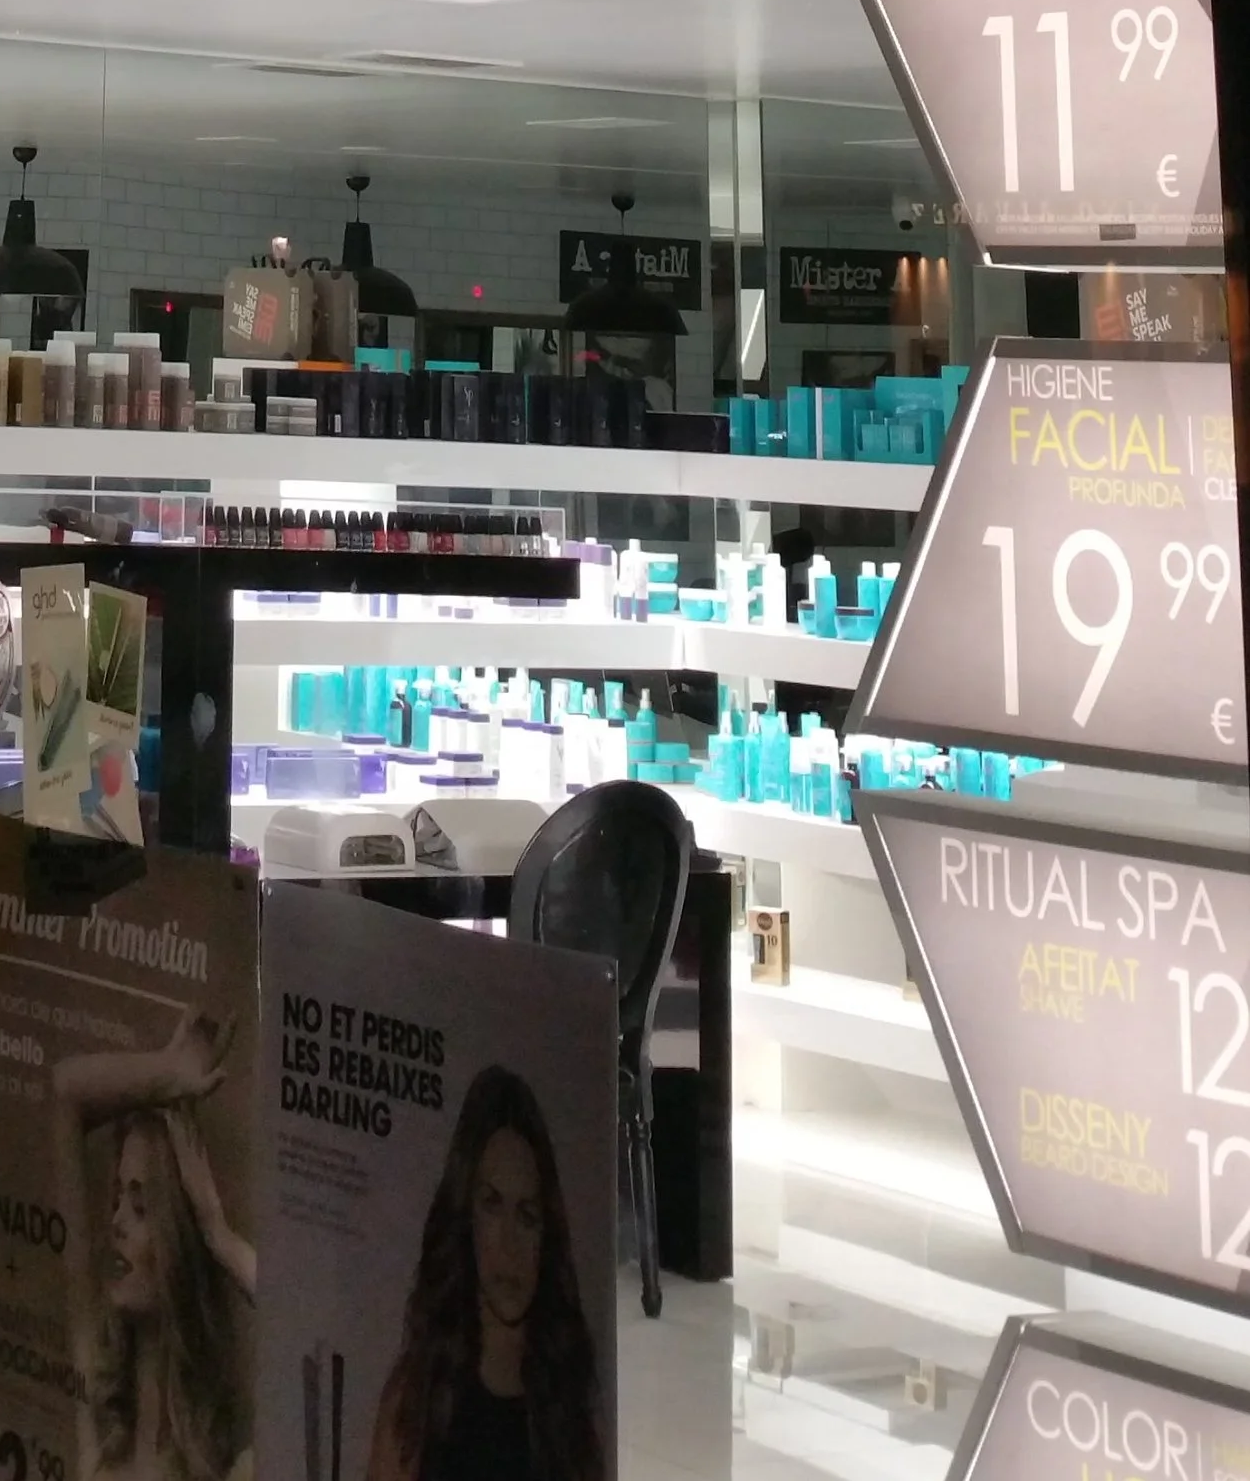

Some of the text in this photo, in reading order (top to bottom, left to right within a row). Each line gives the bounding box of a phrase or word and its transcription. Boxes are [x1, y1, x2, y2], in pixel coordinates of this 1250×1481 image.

[982, 5, 1180, 198] 11 99 €
[789, 255, 883, 291] Mister
[1125, 288, 1147, 311] SAY
[1129, 306, 1149, 327] ME
[1133, 314, 1172, 341] SPEAK
[1007, 364, 1113, 401] HIGIENE
[1010, 407, 1181, 475] FACIAL
[1069, 476, 1186, 509] PROFUNDA
[32, 584, 57, 619] ghd
[982, 525, 1235, 744] 19 99 €
[941, 837, 1227, 954] RITUAL SPA
[78, 903, 209, 984] Promotion
[1018, 942, 1140, 1003] AFEITAT
[283, 992, 445, 1068] NO ET PERDIS
[1020, 985, 1086, 1023] SHAVE
[1168, 966, 1250, 1108] 12
[282, 1035, 444, 1110] LES REBAIXES
[281, 1077, 392, 1138] DARLING
[1020, 1086, 1151, 1159] DISSENY
[1020, 1137, 1170, 1198] BEARD DESIGN
[1187, 1129, 1250, 1272] 12
[1027, 1379, 1188, 1481] COLOR
